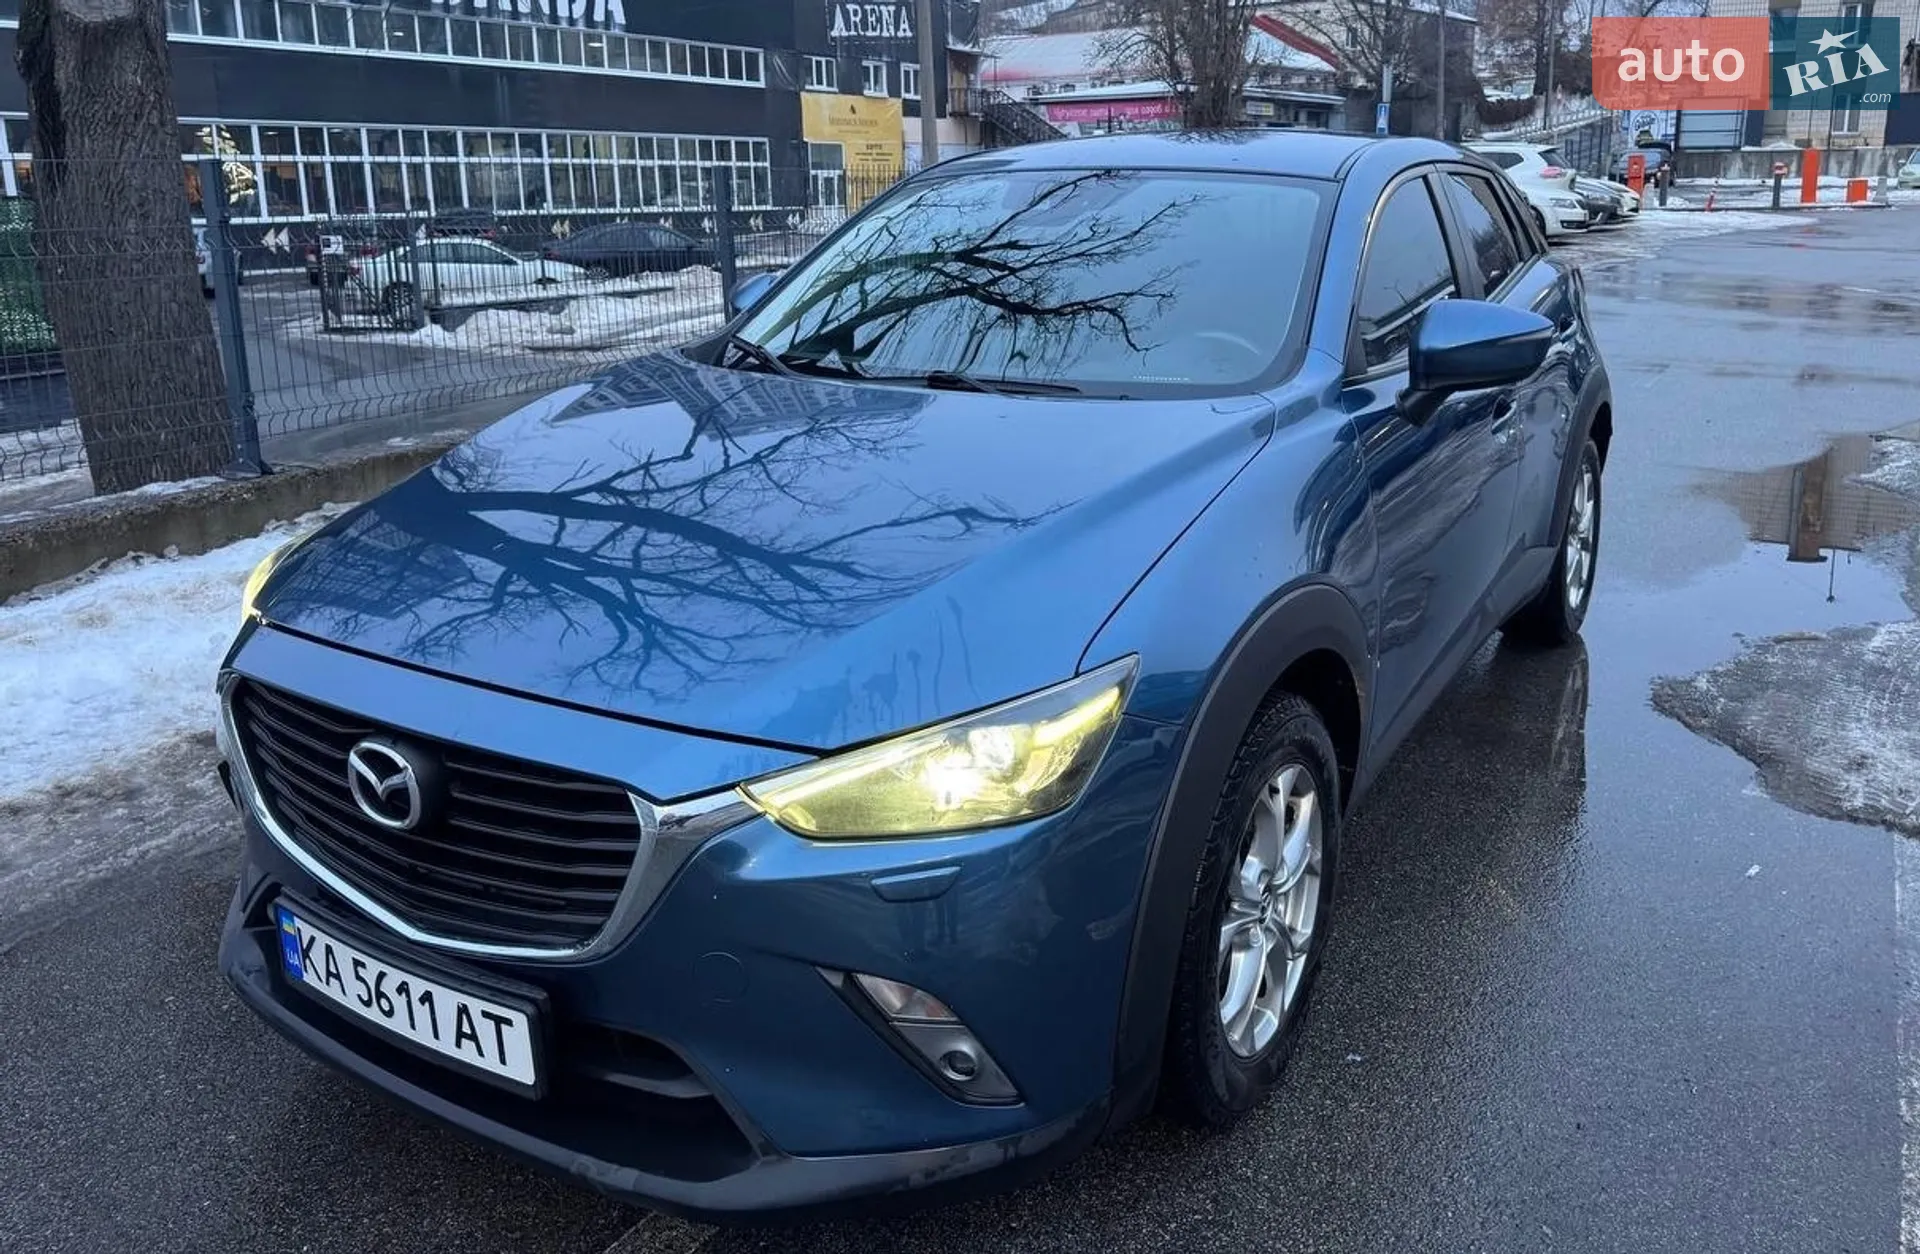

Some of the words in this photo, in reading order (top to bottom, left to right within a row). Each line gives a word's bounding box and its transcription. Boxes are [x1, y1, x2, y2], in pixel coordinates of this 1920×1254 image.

[830, 3, 914, 38] ARENA
[296, 926, 346, 997] KA
[351, 955, 440, 1041] 5611
[454, 1000, 514, 1067] AT
